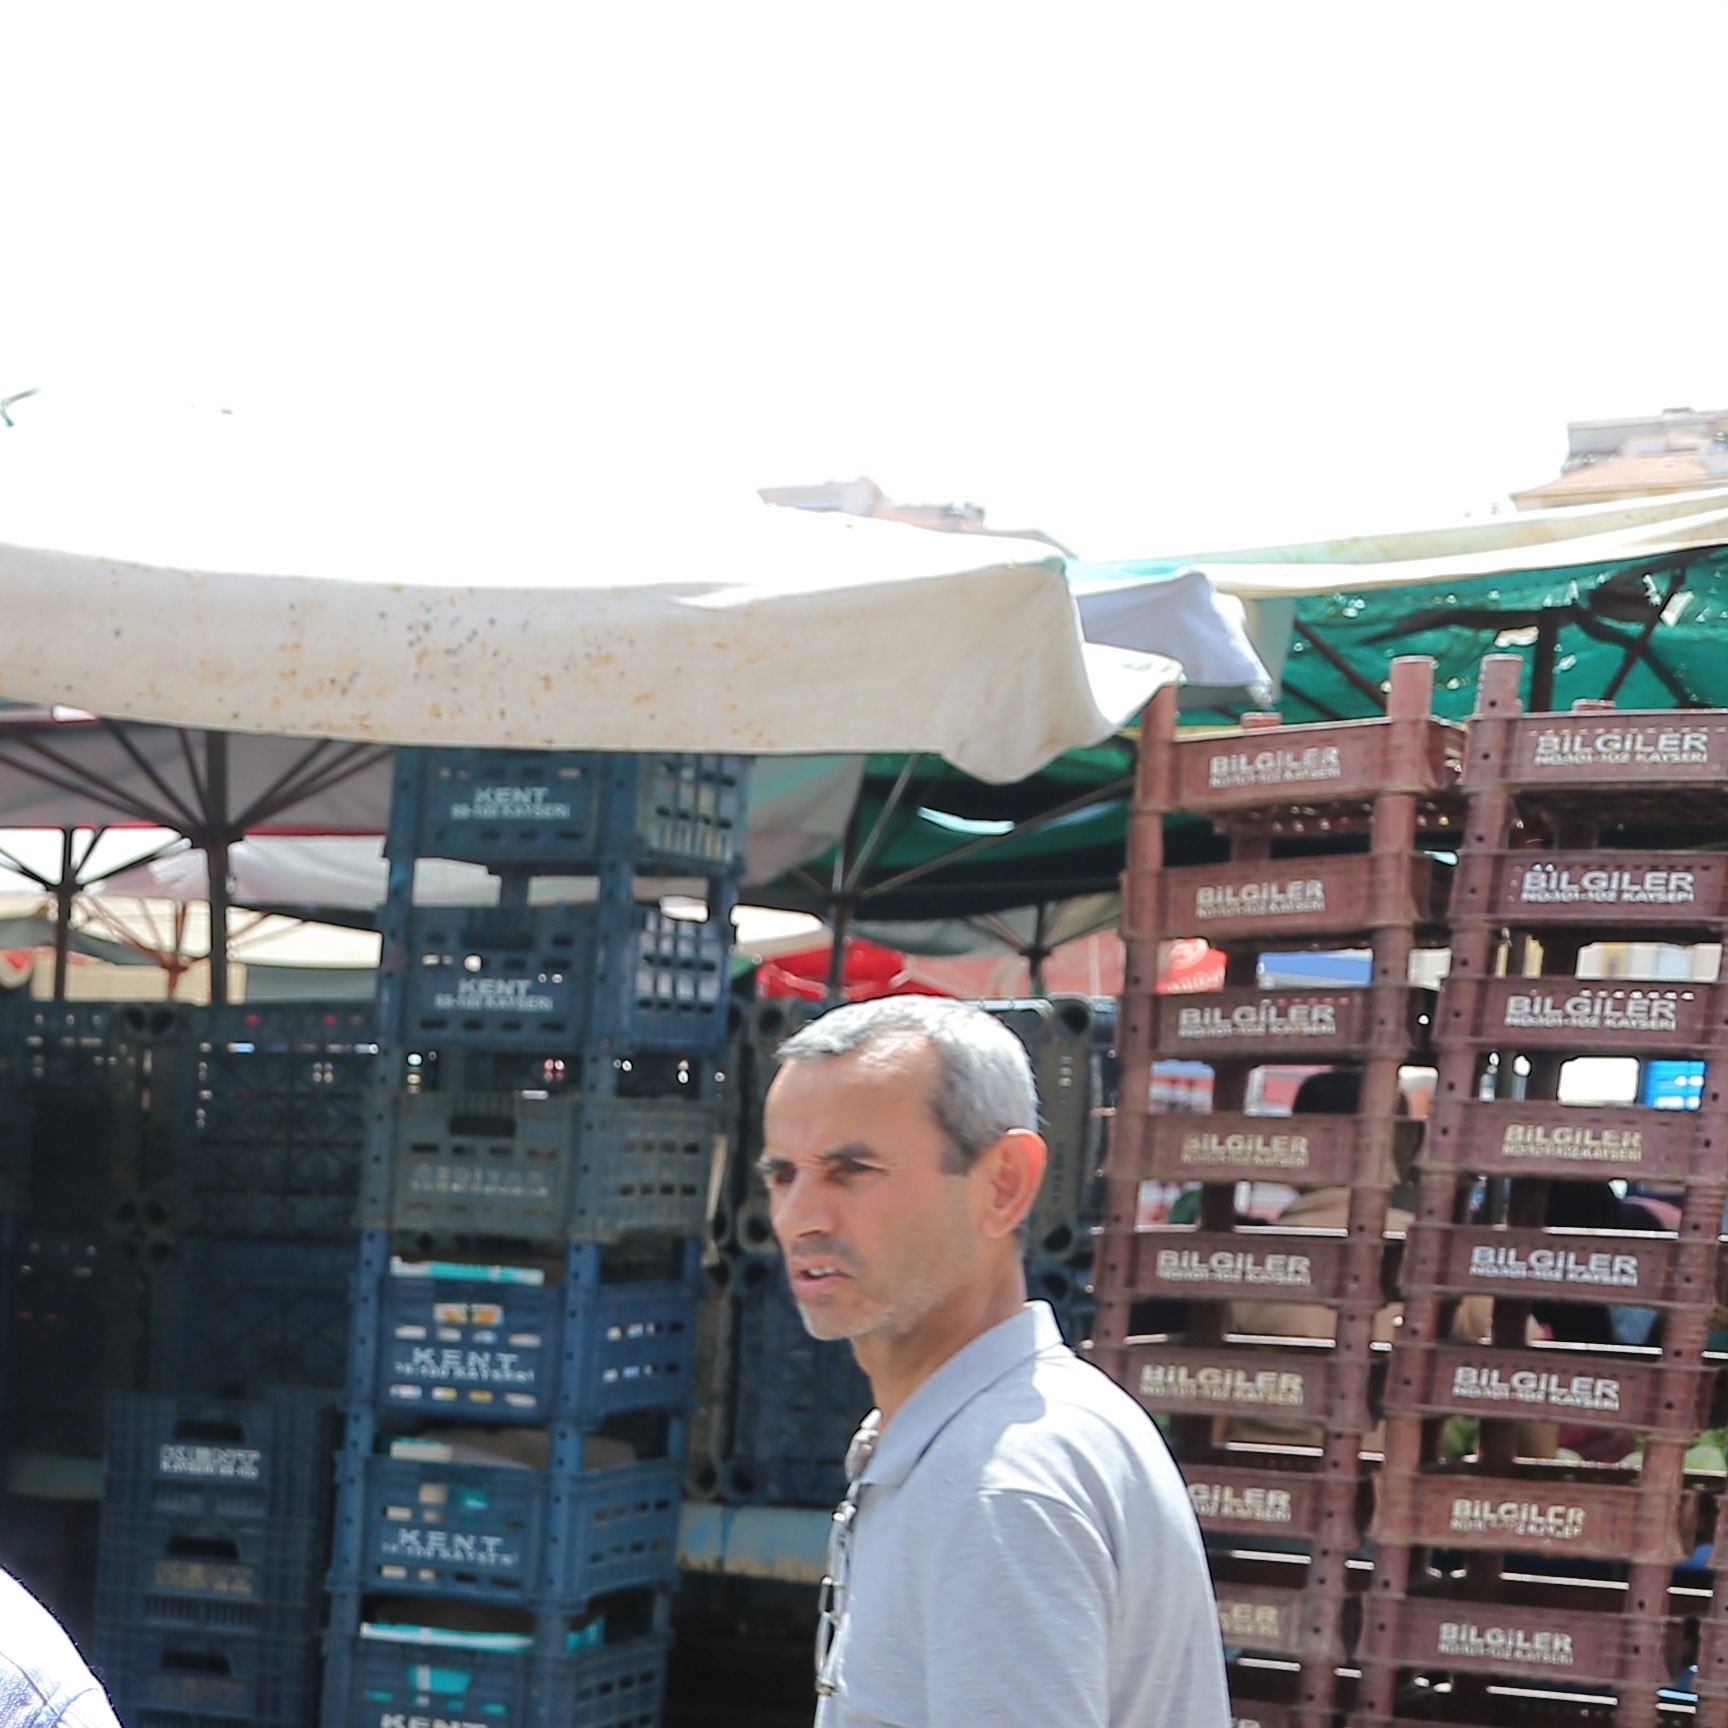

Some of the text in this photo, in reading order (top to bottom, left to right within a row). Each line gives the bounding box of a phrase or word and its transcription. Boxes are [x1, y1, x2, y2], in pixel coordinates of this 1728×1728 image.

[475, 787, 549, 802] KENT
[458, 977, 532, 995] KENT
[412, 1347, 518, 1370] KENT
[399, 1529, 503, 1554] KENT
